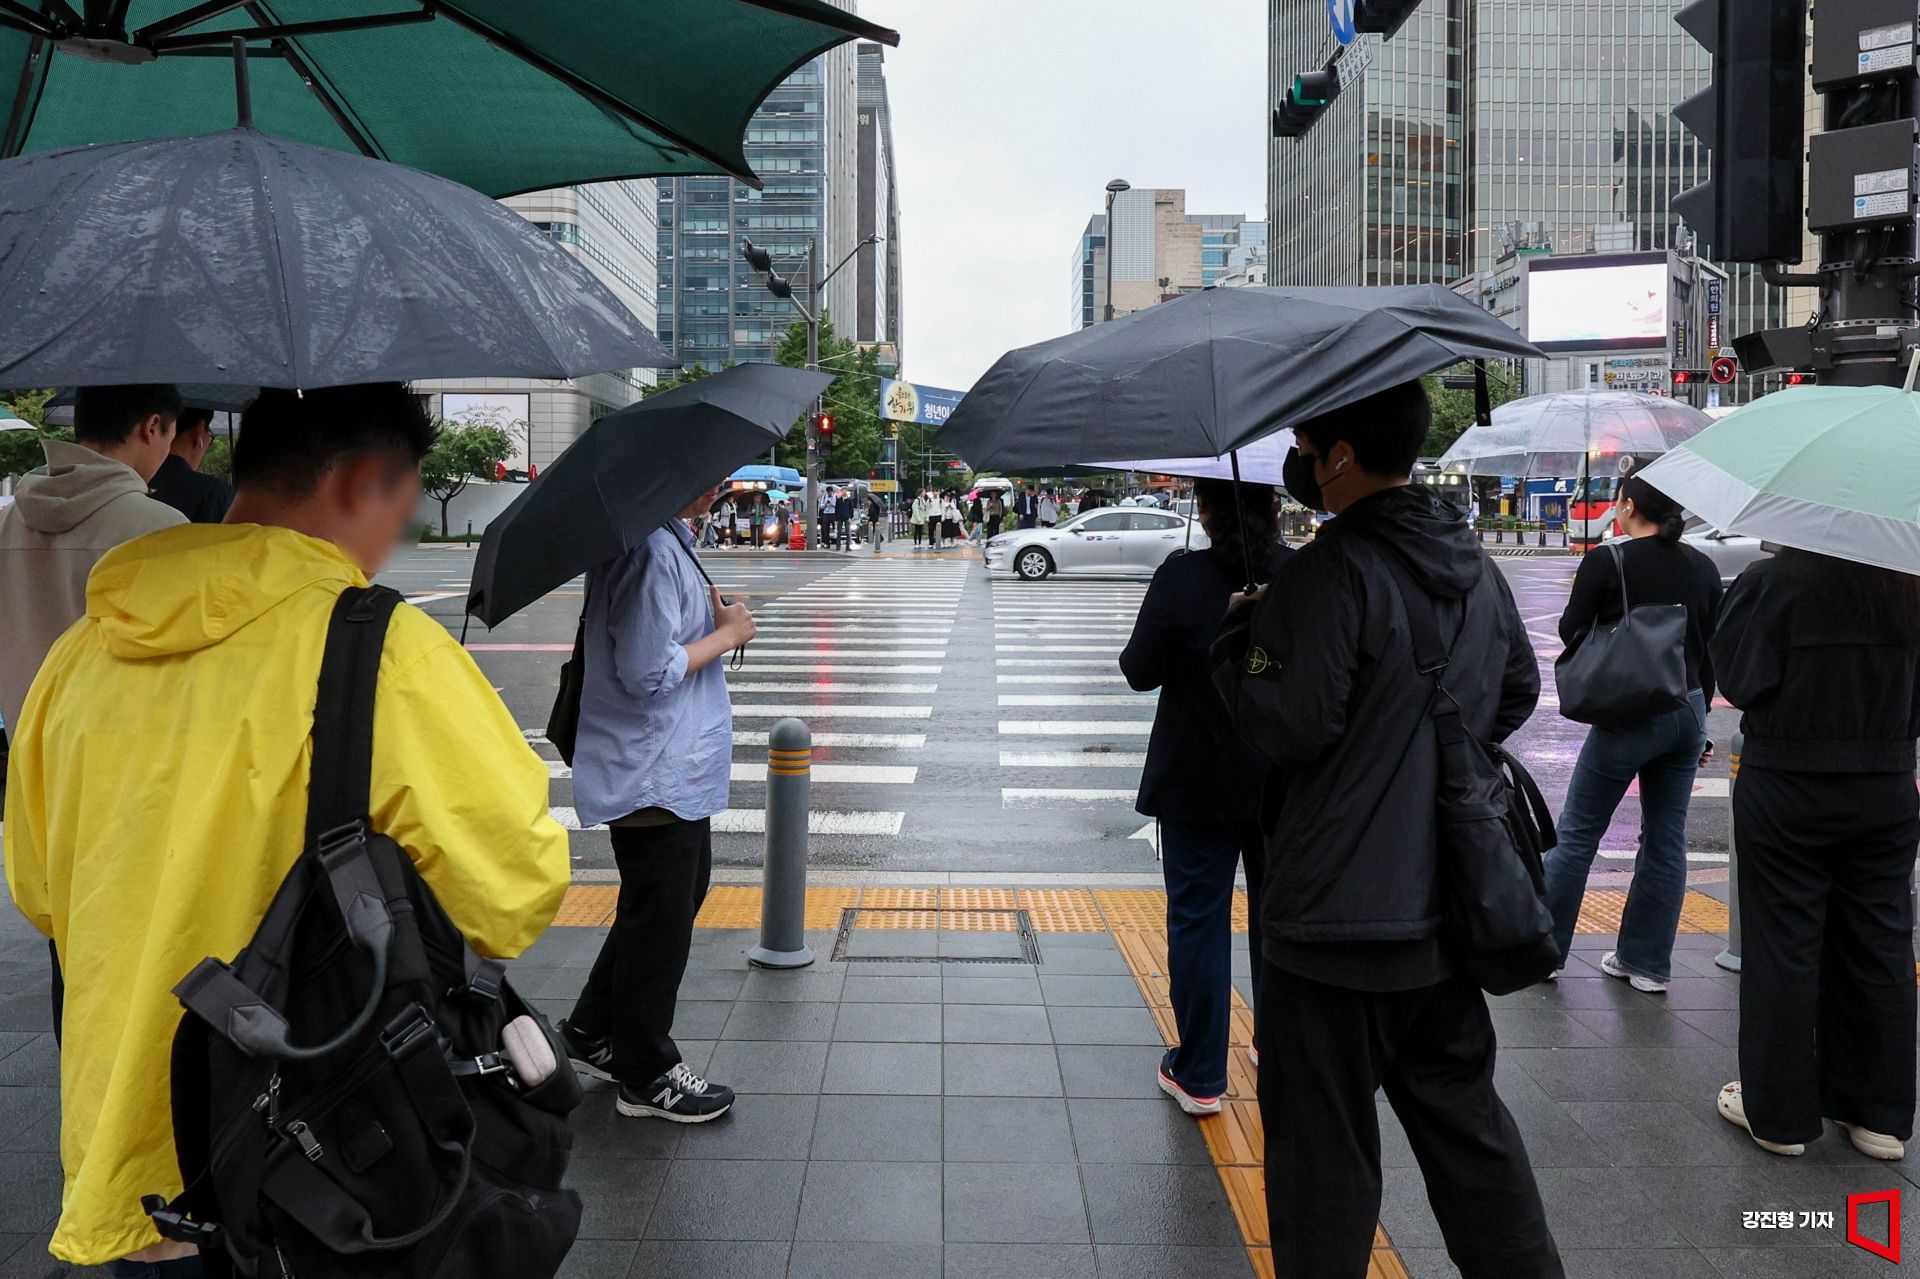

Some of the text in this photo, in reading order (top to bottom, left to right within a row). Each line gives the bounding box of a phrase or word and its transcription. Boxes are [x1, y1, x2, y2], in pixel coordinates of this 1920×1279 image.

[1710, 285, 1719, 312] 한의원
[1605, 370, 1664, 384] 강비뇨기과
[887, 396, 915, 416] 한가위
[924, 403, 950, 420] 청년이
[652, 1087, 684, 1110] N
